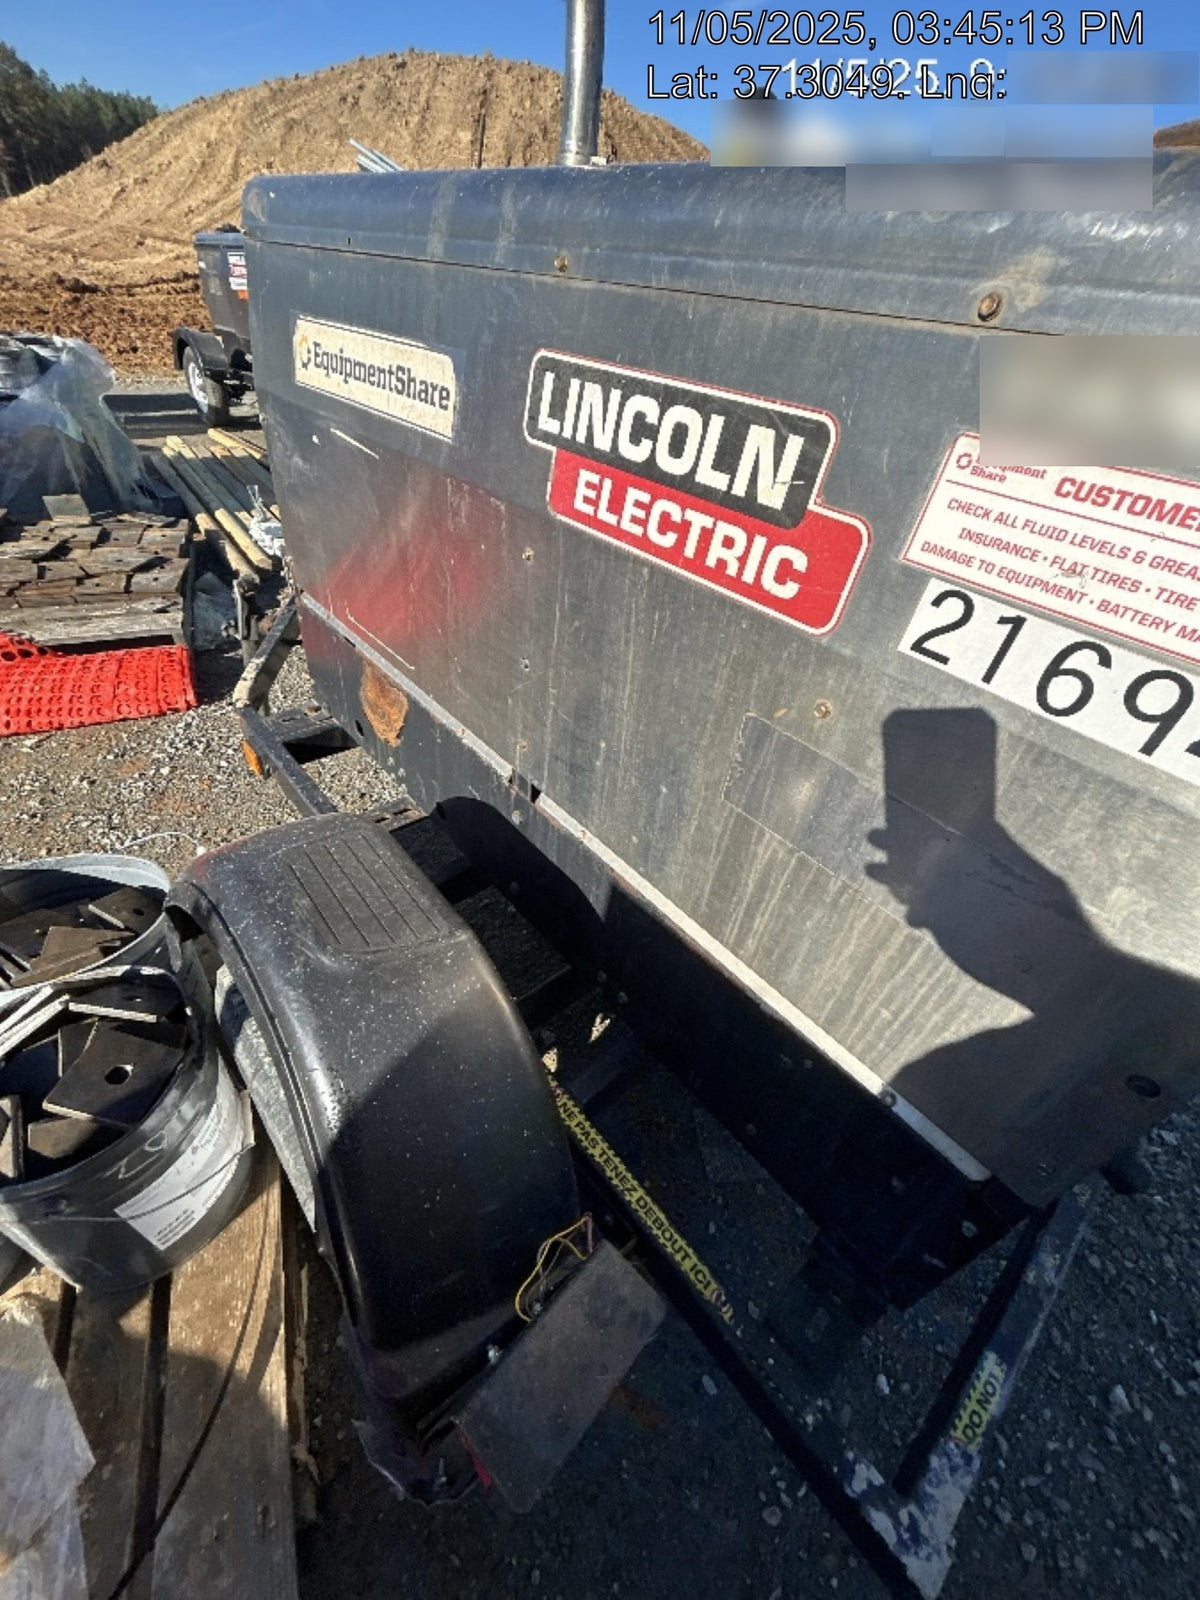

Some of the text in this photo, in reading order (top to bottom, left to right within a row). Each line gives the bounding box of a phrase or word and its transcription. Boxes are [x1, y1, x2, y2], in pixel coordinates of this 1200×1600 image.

[312, 341, 451, 411] EquipmentShare
[537, 371, 805, 511] LINCOLN
[970, 465, 1007, 483] Share
[573, 468, 809, 600] ELECTRIC
[947, 497, 1200, 582] CHECK ALL FLUID LEVELS & GREA
[1054, 476, 1200, 532] CUSTOME
[920, 540, 976, 568] DAMAGE
[977, 559, 996, 575] TO
[997, 566, 1088, 604] EQUIPMENT
[1096, 598, 1177, 633] BATTERY
[958, 527, 1042, 562] INSURANCE
[1048, 555, 1089, 577] FLAT
[1090, 566, 1143, 593] TIRES
[909, 589, 1200, 757] 2169
[560, 1102, 711, 1291] NE PAS TENEZ DEBOUT ICI
[962, 1409, 983, 1444] DO
